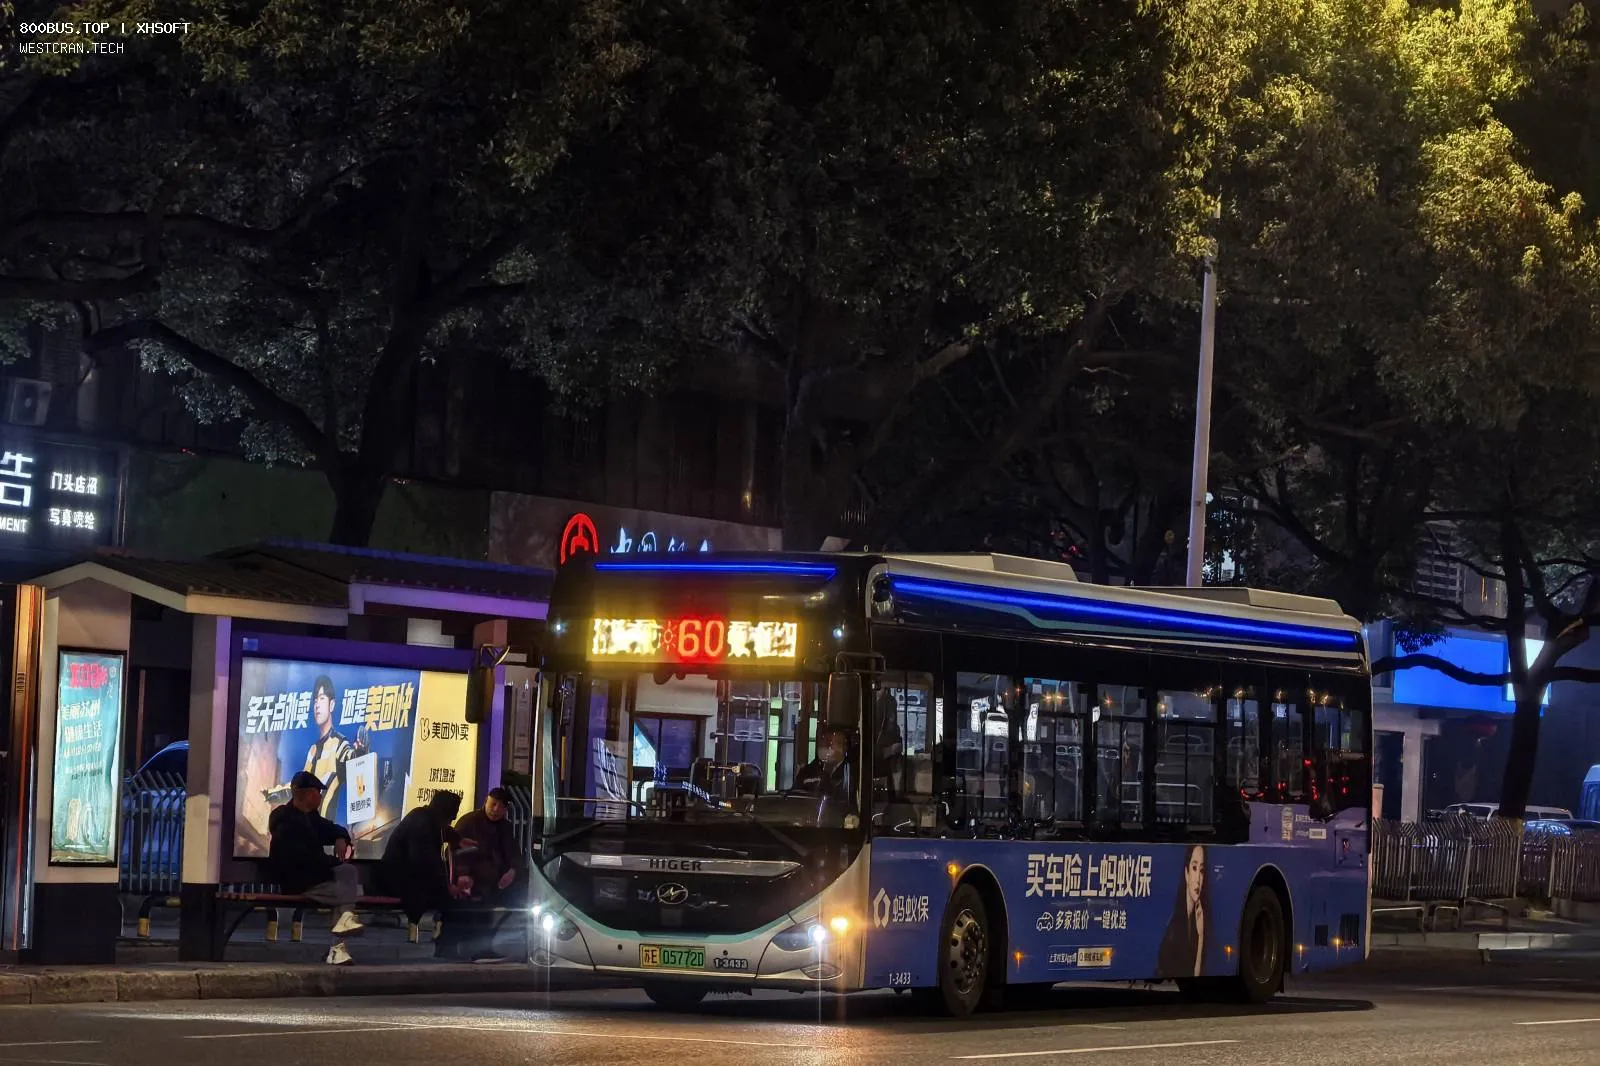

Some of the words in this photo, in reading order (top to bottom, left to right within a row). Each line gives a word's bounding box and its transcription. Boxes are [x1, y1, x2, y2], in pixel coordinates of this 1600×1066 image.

[0, 451, 33, 507] 告
[50, 471, 98, 495] 门头店招
[49, 507, 95, 530] 写真喷绘
[677, 619, 725, 658] 60
[246, 691, 312, 734] 冬天点外卖
[339, 682, 415, 731] 还是美团快
[432, 721, 470, 741] 美团外卖
[350, 798, 372, 812] 美团外卖
[649, 858, 702, 871] HIGER
[1025, 853, 1153, 898] 买车险上蚂蚁保
[892, 894, 929, 923] 蚂蚁保
[1055, 908, 1090, 931] 多家报价
[1093, 908, 1128, 931] 一键优选
[714, 958, 748, 968] 1-3433
[889, 972, 911, 985] 1-3433
